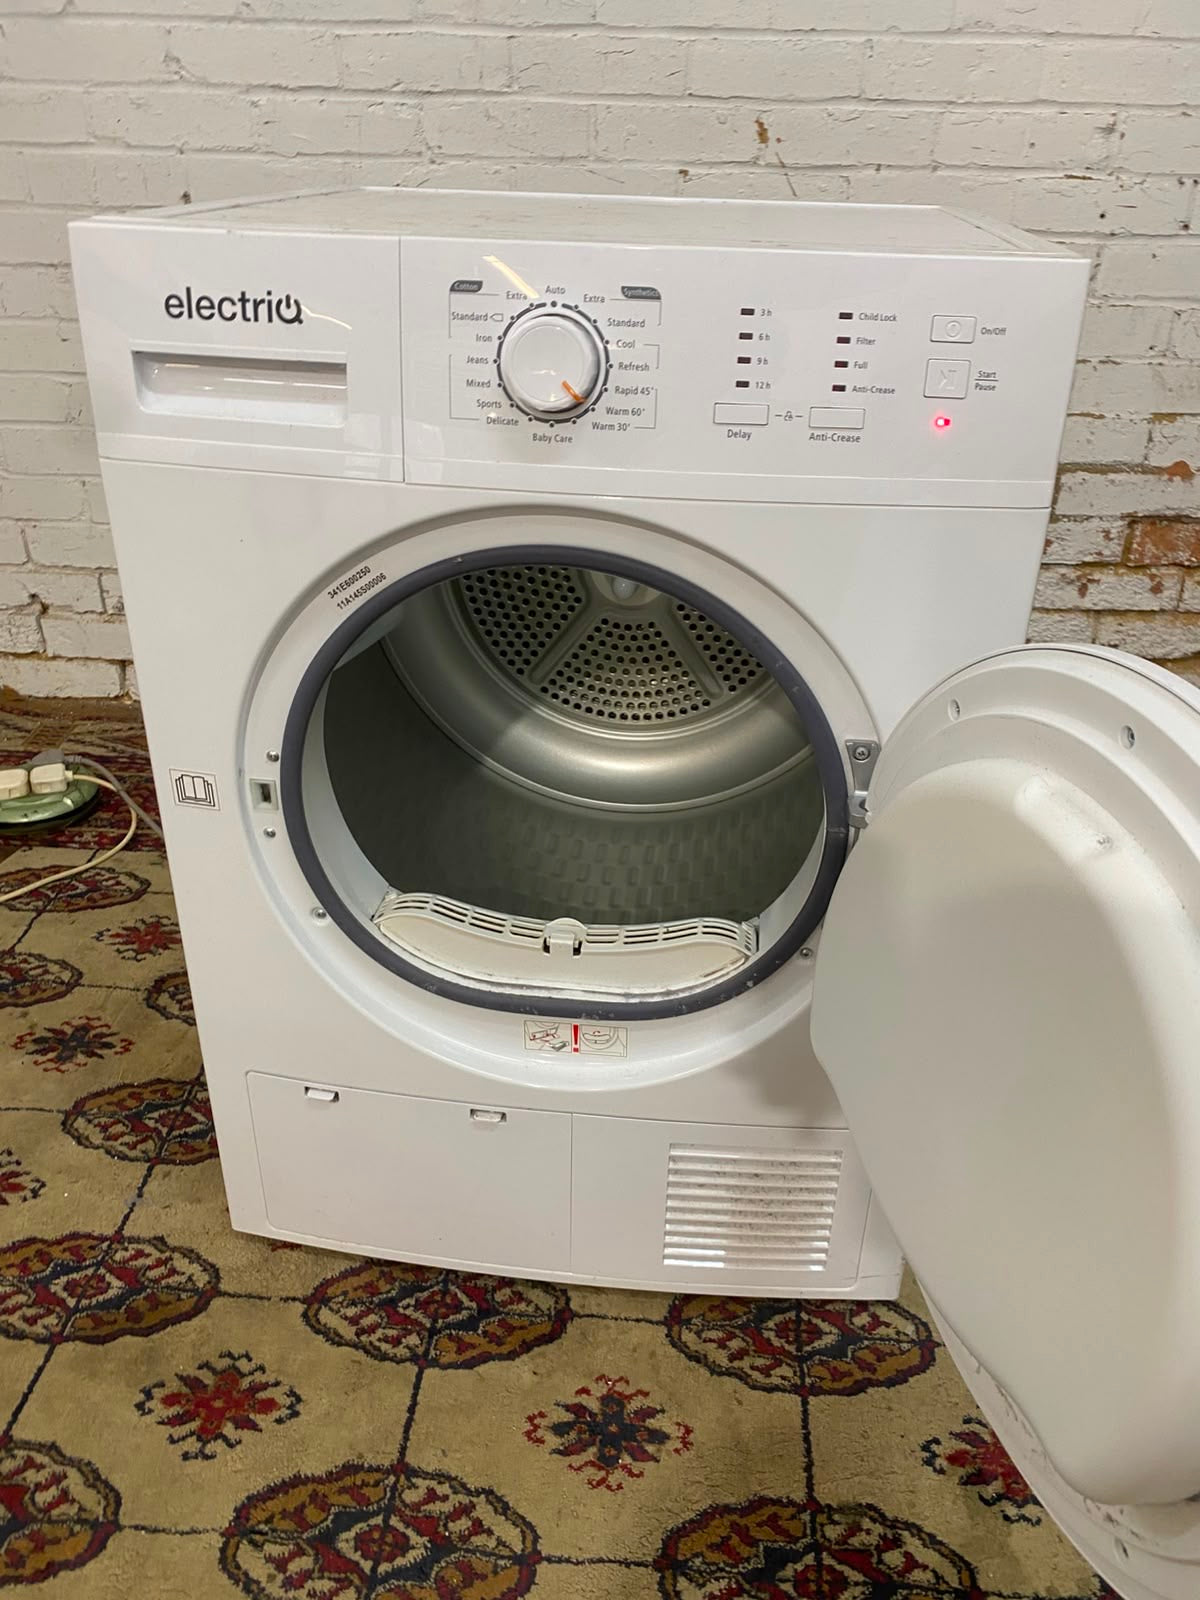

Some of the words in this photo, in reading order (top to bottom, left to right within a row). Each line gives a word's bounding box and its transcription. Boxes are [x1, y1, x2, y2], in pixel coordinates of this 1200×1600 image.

[454, 282, 479, 291] Cotton
[545, 285, 566, 295] Auto
[506, 290, 528, 300] Extra
[583, 293, 605, 303] Extra
[451, 311, 488, 321] Standard
[760, 308, 767, 317] 3
[767, 308, 772, 317] h
[858, 312, 879, 322] Child
[880, 313, 897, 322] Lock
[607, 317, 646, 328] Standard
[758, 333, 765, 341] 6
[765, 332, 770, 341] h
[980, 327, 1007, 336] On/Off
[475, 333, 493, 342] Iron
[856, 336, 876, 345] Filter
[616, 339, 636, 349] Cool
[466, 355, 489, 365] Jeans
[757, 357, 763, 366] 9
[763, 357, 769, 365] h
[854, 360, 868, 369] Full
[618, 361, 650, 372] Refresh
[978, 370, 997, 379] Start
[466, 379, 491, 388] Mixed
[755, 381, 766, 390] 12
[974, 382, 996, 392] Pause
[615, 386, 638, 396] Rapid
[852, 385, 896, 395] Anti-Crease
[476, 399, 502, 409] Sports
[606, 406, 630, 416] Warm
[486, 416, 520, 426] Delicate
[592, 422, 616, 432] Warm
[532, 433, 552, 444] Baby
[553, 434, 573, 444] Care
[727, 429, 752, 441] Delay
[809, 432, 861, 443] Anti-Crease
[327, 565, 372, 600] 341E600250
